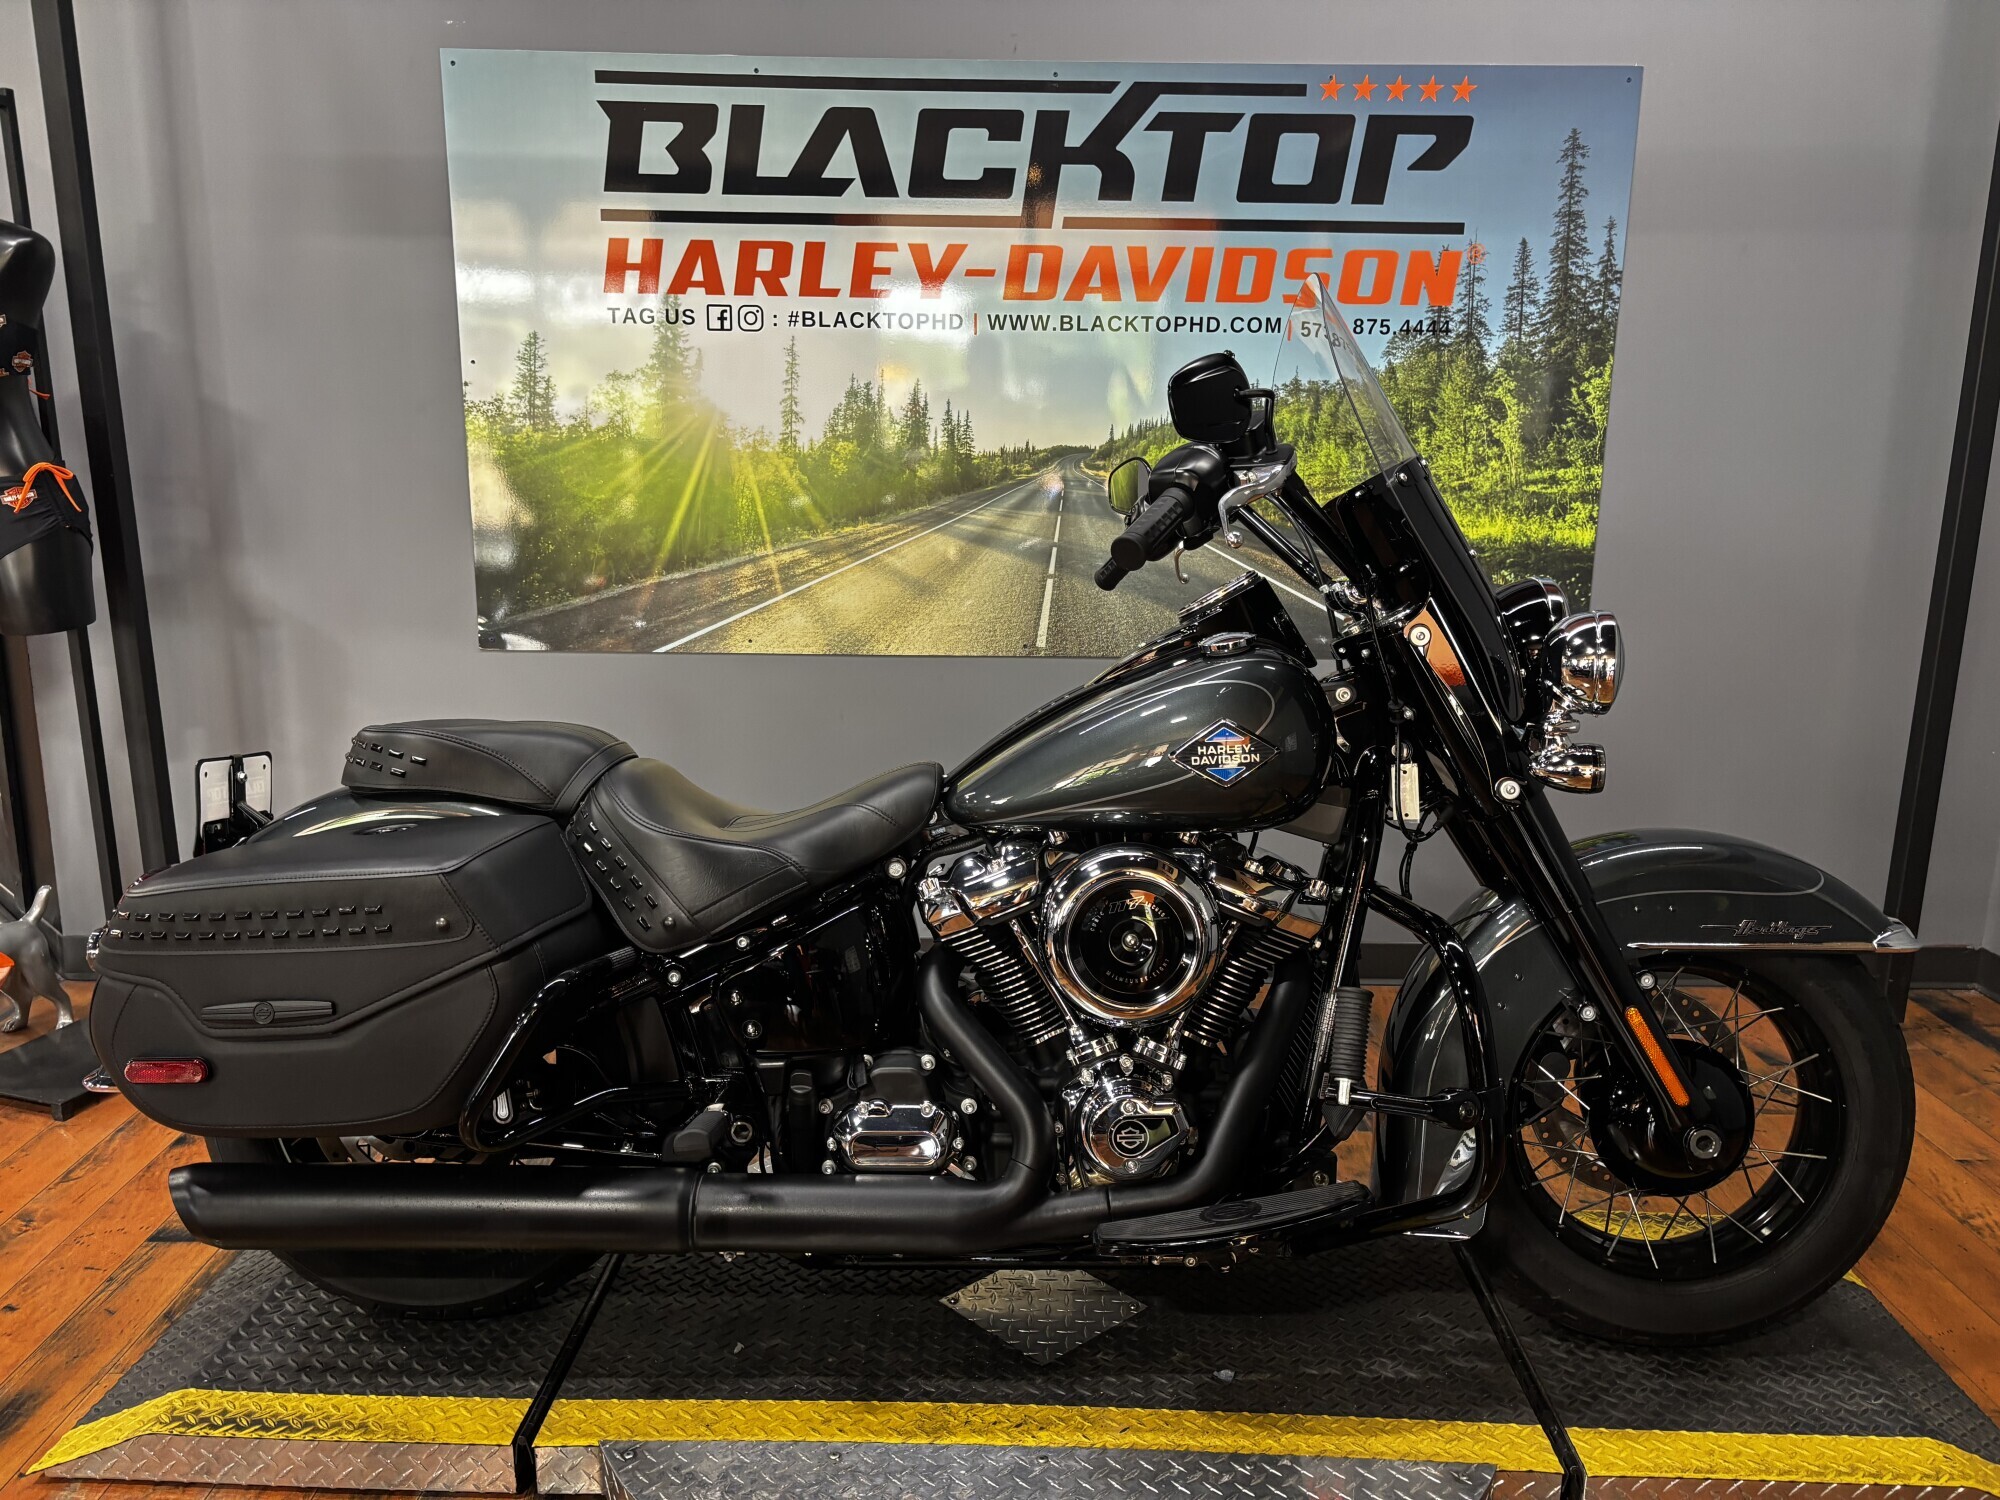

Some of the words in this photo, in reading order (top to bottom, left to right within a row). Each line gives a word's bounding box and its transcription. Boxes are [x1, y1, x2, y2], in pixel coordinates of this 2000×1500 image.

[596, 82, 1474, 229] BLACKTOP
[607, 307, 655, 325] TAG
[665, 308, 696, 326] US
[788, 310, 963, 330] #BLACKTOPHD
[987, 313, 1281, 334] WWW.BLACKTOPHD.COM
[1197, 743, 1255, 756] HARLEY-
[1191, 753, 1260, 767] DAVIDSON
